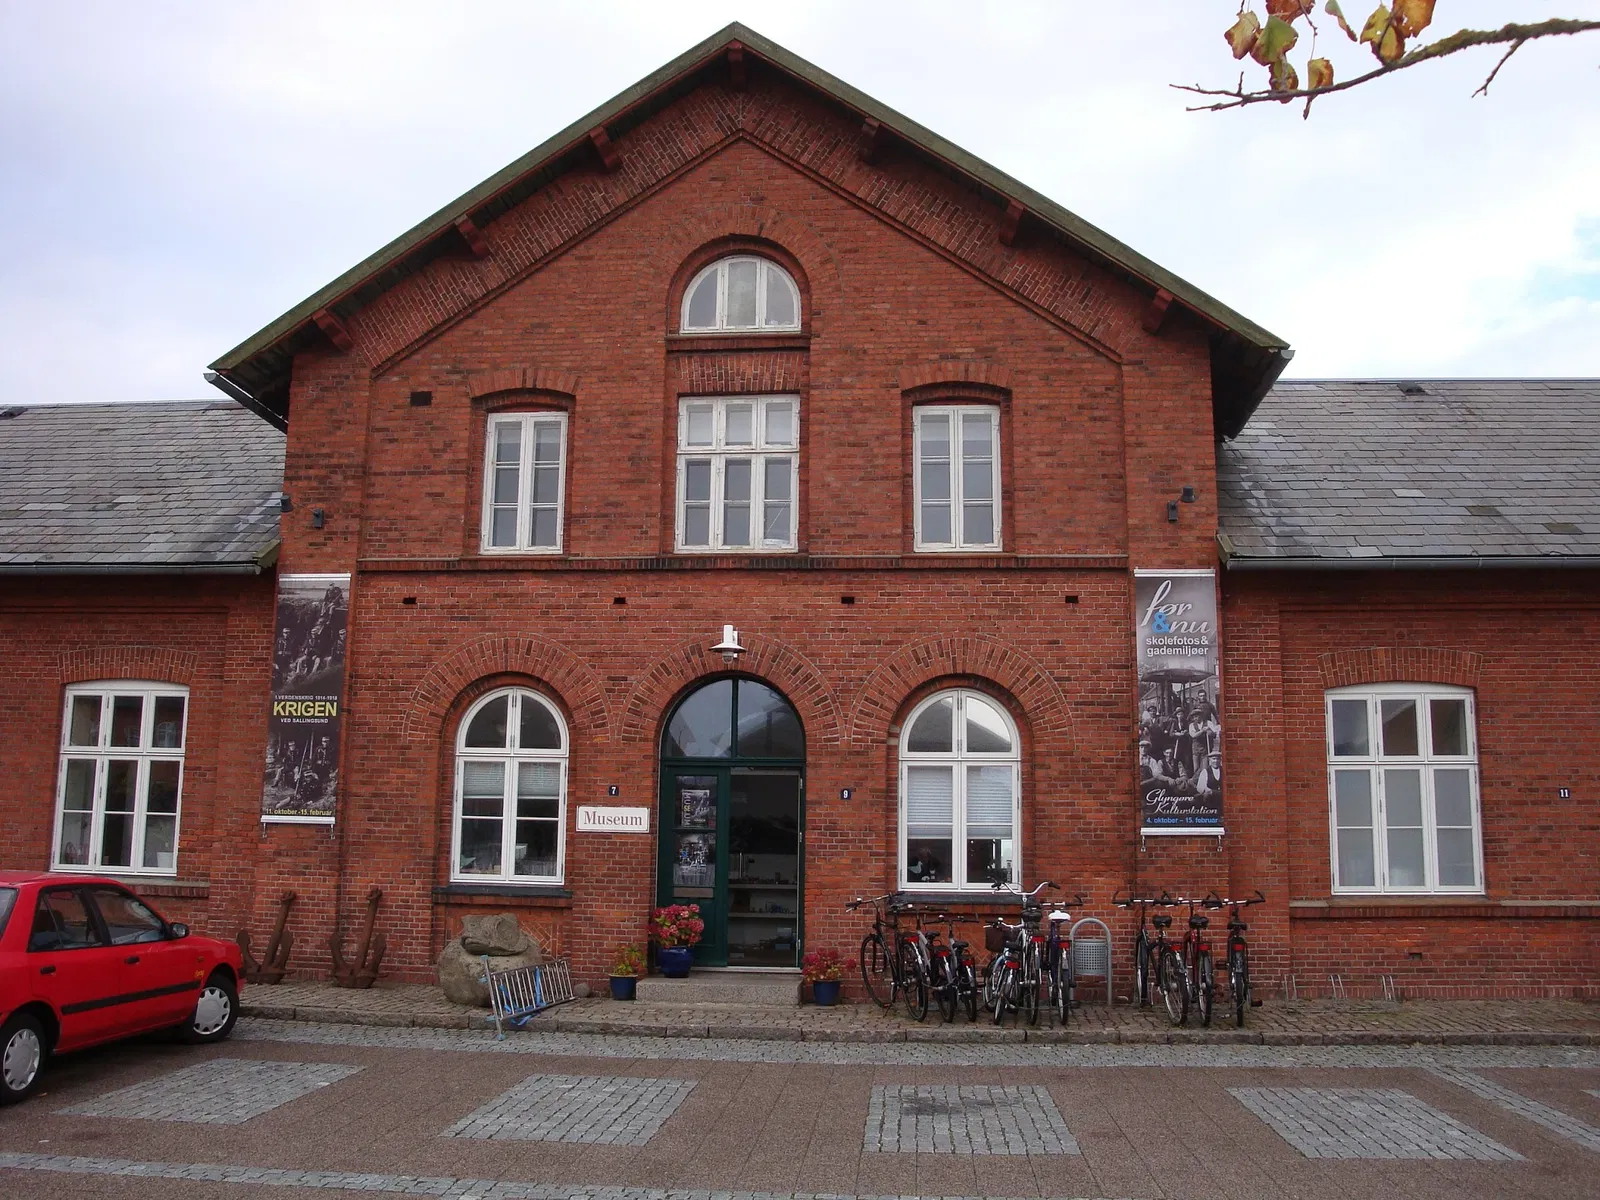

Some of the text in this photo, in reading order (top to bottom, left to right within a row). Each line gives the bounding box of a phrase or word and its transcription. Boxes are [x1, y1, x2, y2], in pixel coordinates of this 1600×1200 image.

[1152, 611, 1210, 633] & nu
[1147, 646, 1208, 657] gademiljøer
[273, 701, 338, 716] KRIGEN
[611, 786, 616, 794] 7
[843, 789, 849, 799] 9
[1560, 789, 1569, 798] 11
[583, 810, 642, 826] Museum
[1195, 816, 1219, 824] februar
